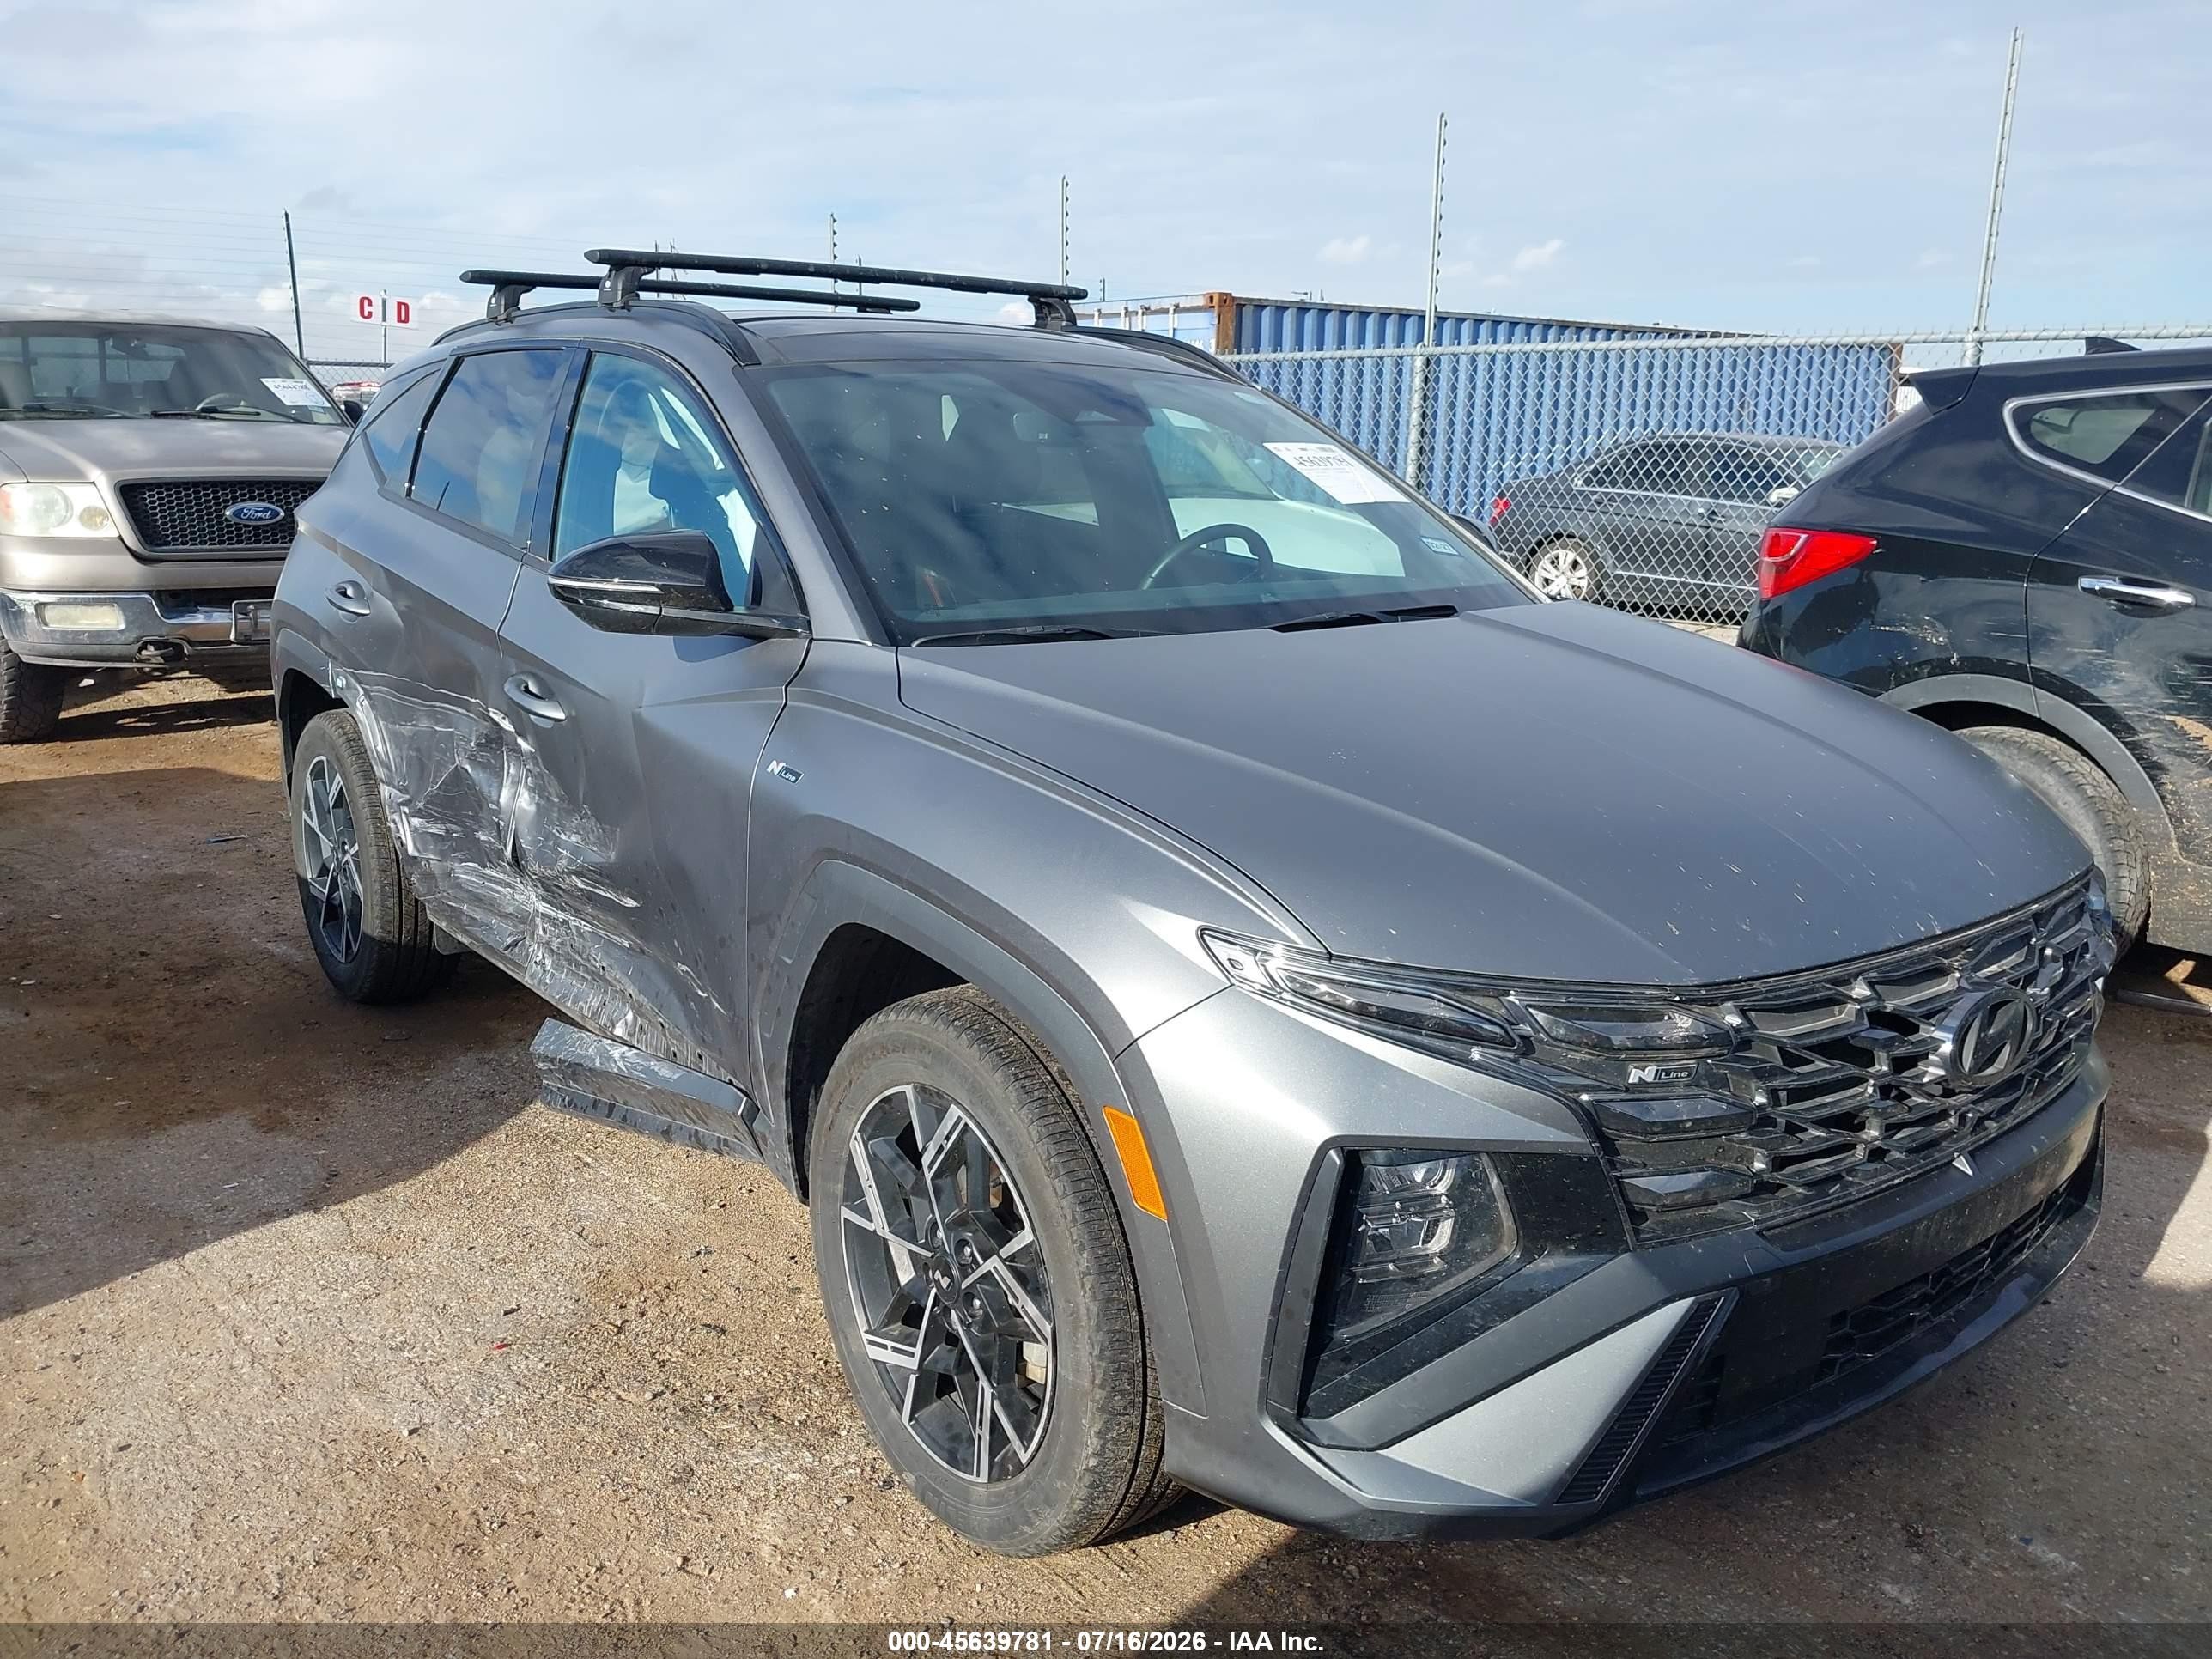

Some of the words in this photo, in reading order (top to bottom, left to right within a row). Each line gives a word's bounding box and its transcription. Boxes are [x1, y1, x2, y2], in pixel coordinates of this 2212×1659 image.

[359, 296, 373, 319] C
[397, 301, 410, 324] D
[240, 507, 272, 520] Ford
[766, 759, 786, 775] N
[781, 769, 796, 782] Line
[1628, 1066, 1657, 1084] N
[1661, 1070, 1689, 1079] Line
